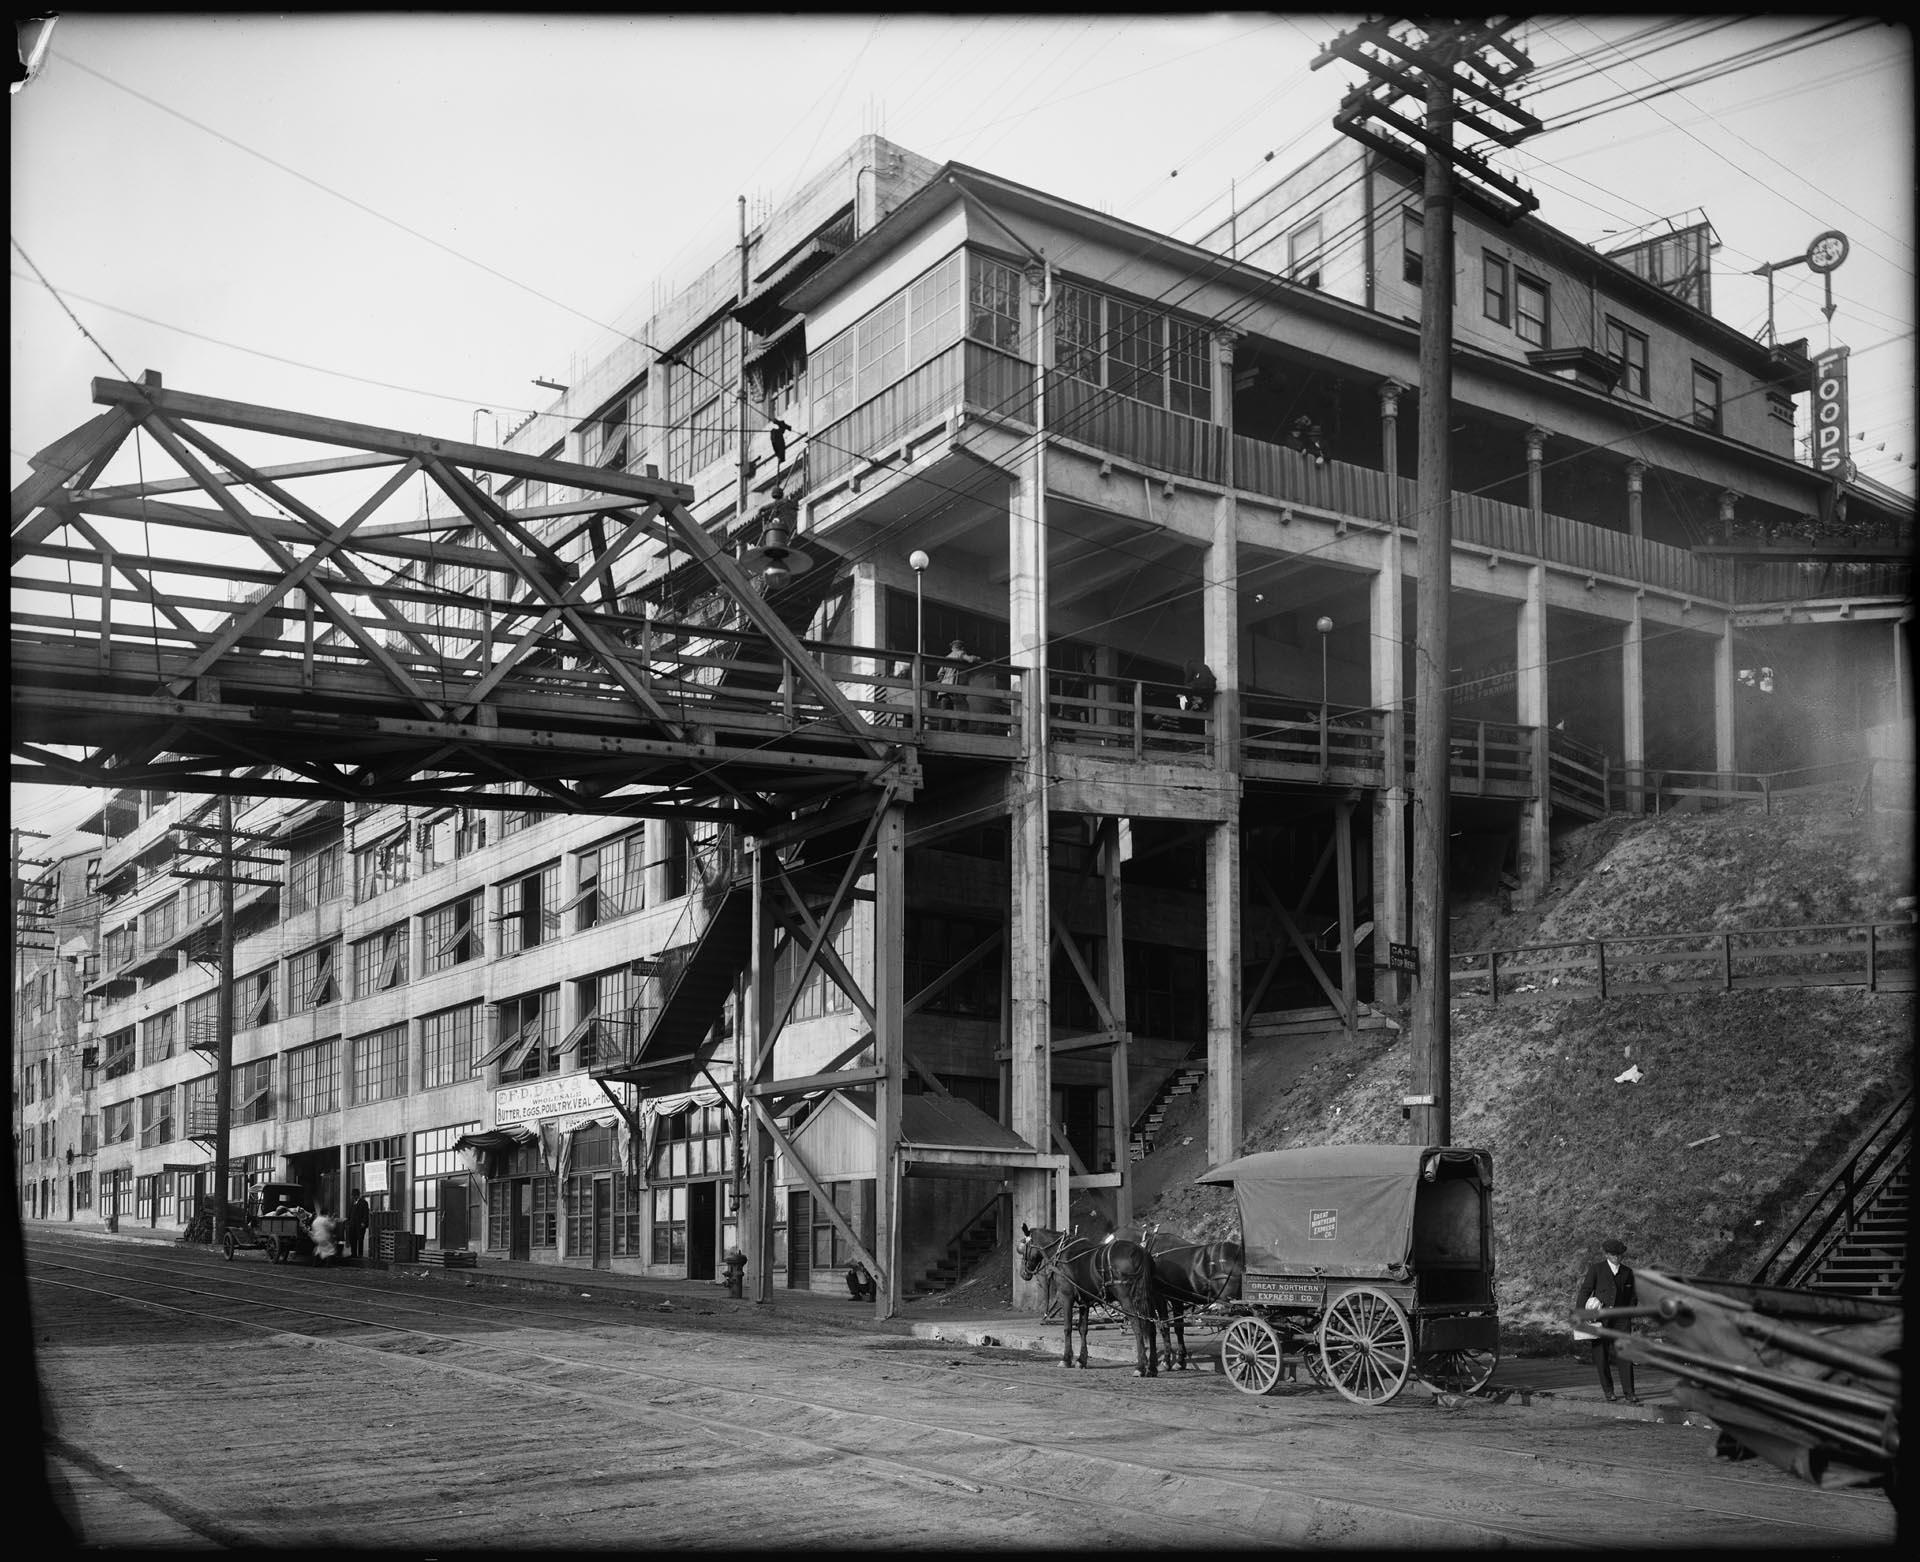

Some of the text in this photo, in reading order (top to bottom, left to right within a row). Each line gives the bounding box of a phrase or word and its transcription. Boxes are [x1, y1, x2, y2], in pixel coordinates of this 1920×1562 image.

[1818, 353, 1841, 471] FOODS
[572, 1096, 592, 1109] VEAL
[1311, 1216, 1336, 1228] NORTHERN
[1313, 1211, 1329, 1221] GREAT
[1313, 1223, 1335, 1235] EXPRESS
[1279, 1284, 1319, 1292] NORTHERN
[1258, 1292, 1295, 1301] EXPRESS
[1300, 1294, 1314, 1302] CO.
